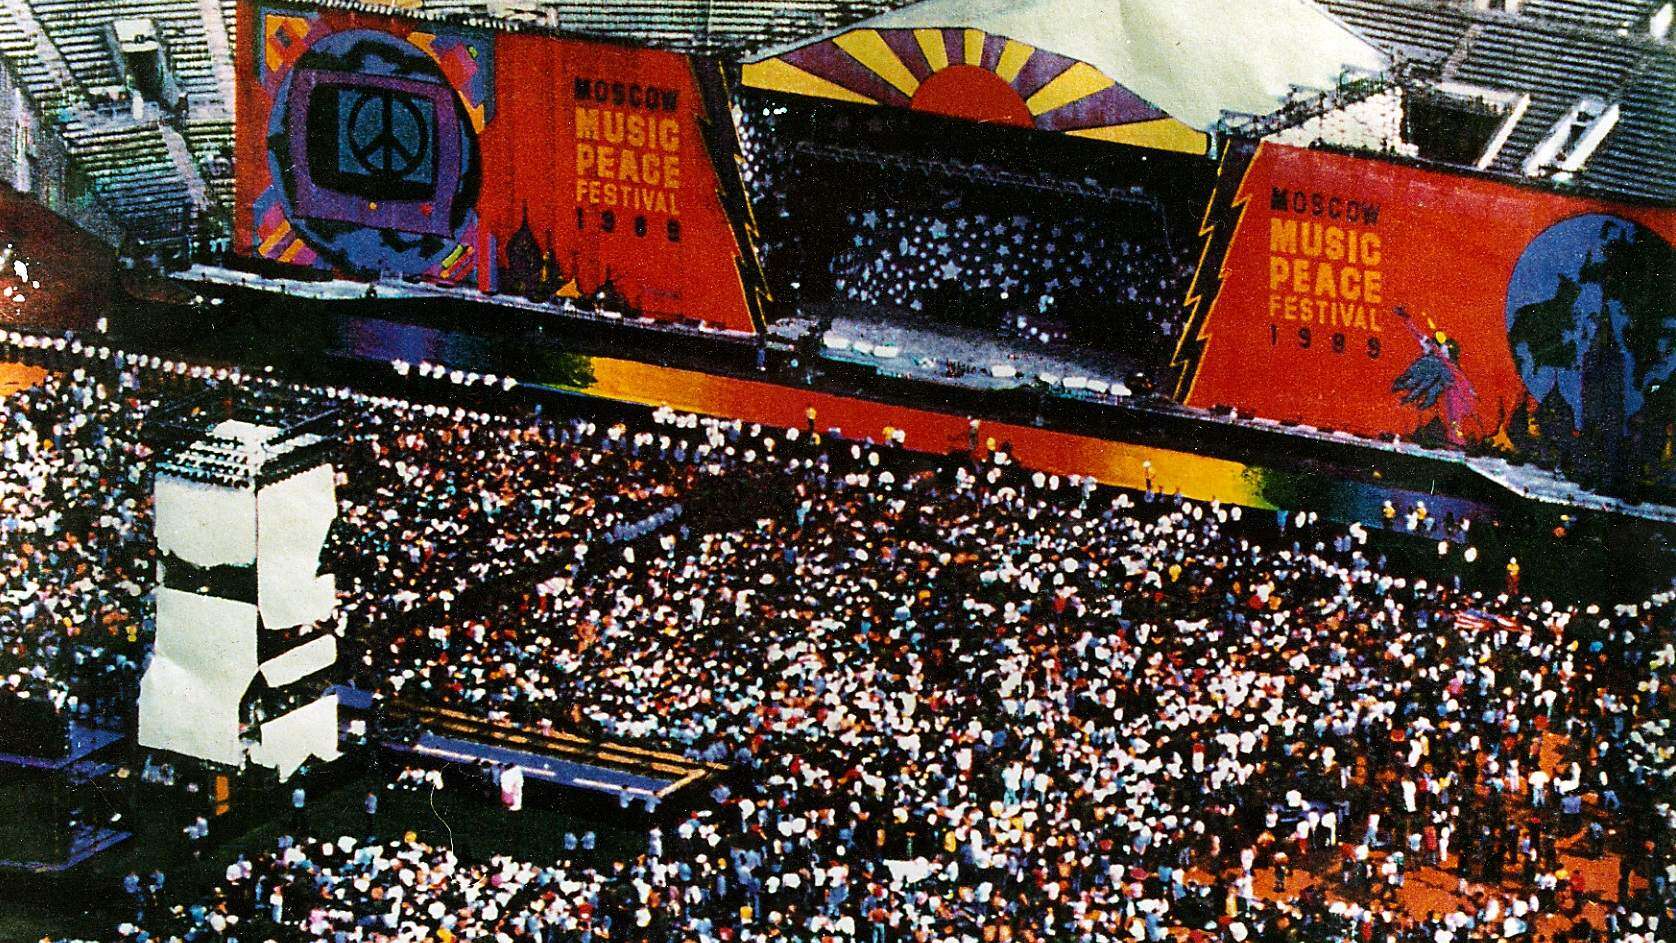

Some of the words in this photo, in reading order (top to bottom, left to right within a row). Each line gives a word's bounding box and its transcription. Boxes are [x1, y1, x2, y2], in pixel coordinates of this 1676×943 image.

[576, 107, 680, 152] MUSIC
[576, 143, 680, 188] PEACE
[576, 178, 680, 216] FESTIVAL
[1270, 186, 1380, 226] MOSCOW
[1271, 218, 1381, 266] MUSIC
[1270, 256, 1381, 303] PEACE
[1269, 294, 1381, 332] FESTIVAL
